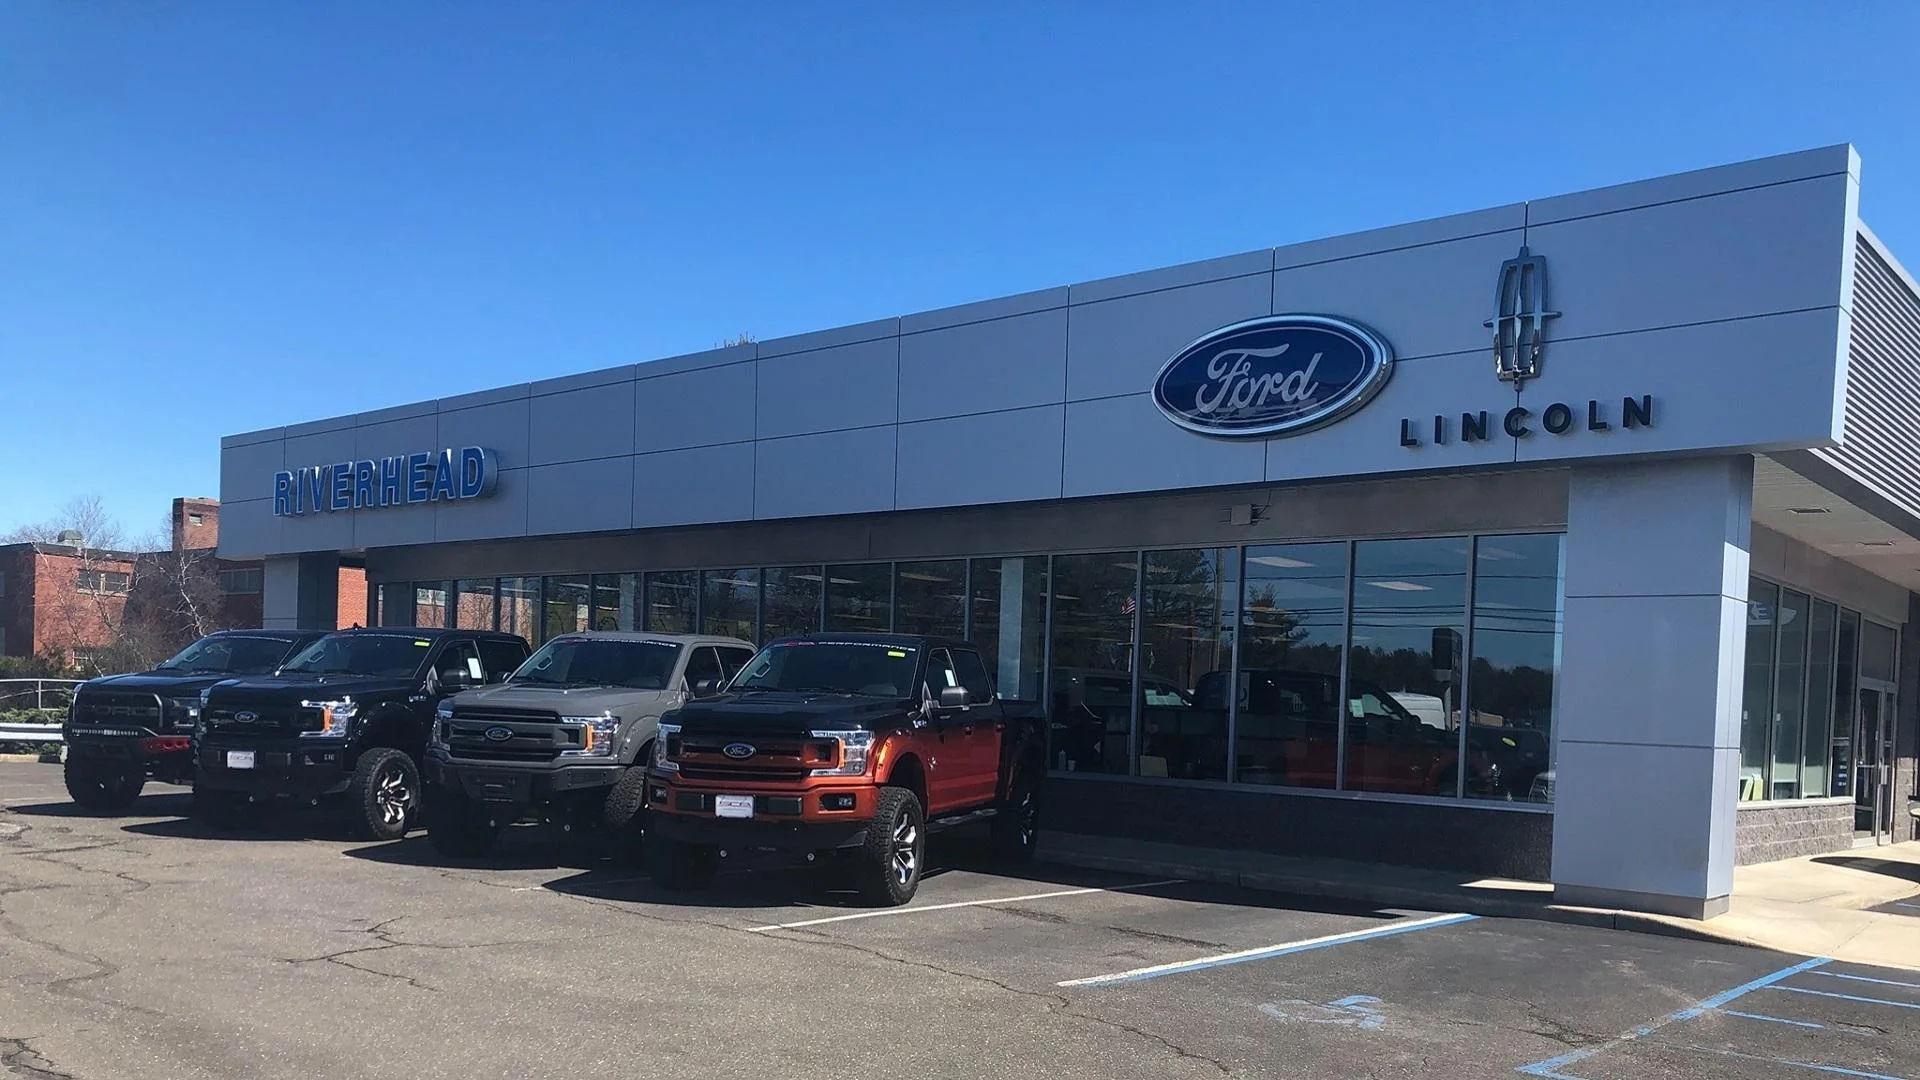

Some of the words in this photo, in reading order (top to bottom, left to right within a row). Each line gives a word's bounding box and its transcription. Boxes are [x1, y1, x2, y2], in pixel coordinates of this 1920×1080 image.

[1195, 343, 1323, 413] Ford
[1400, 394, 1653, 447] LINCOLN
[273, 446, 486, 516] RIVERHEAD
